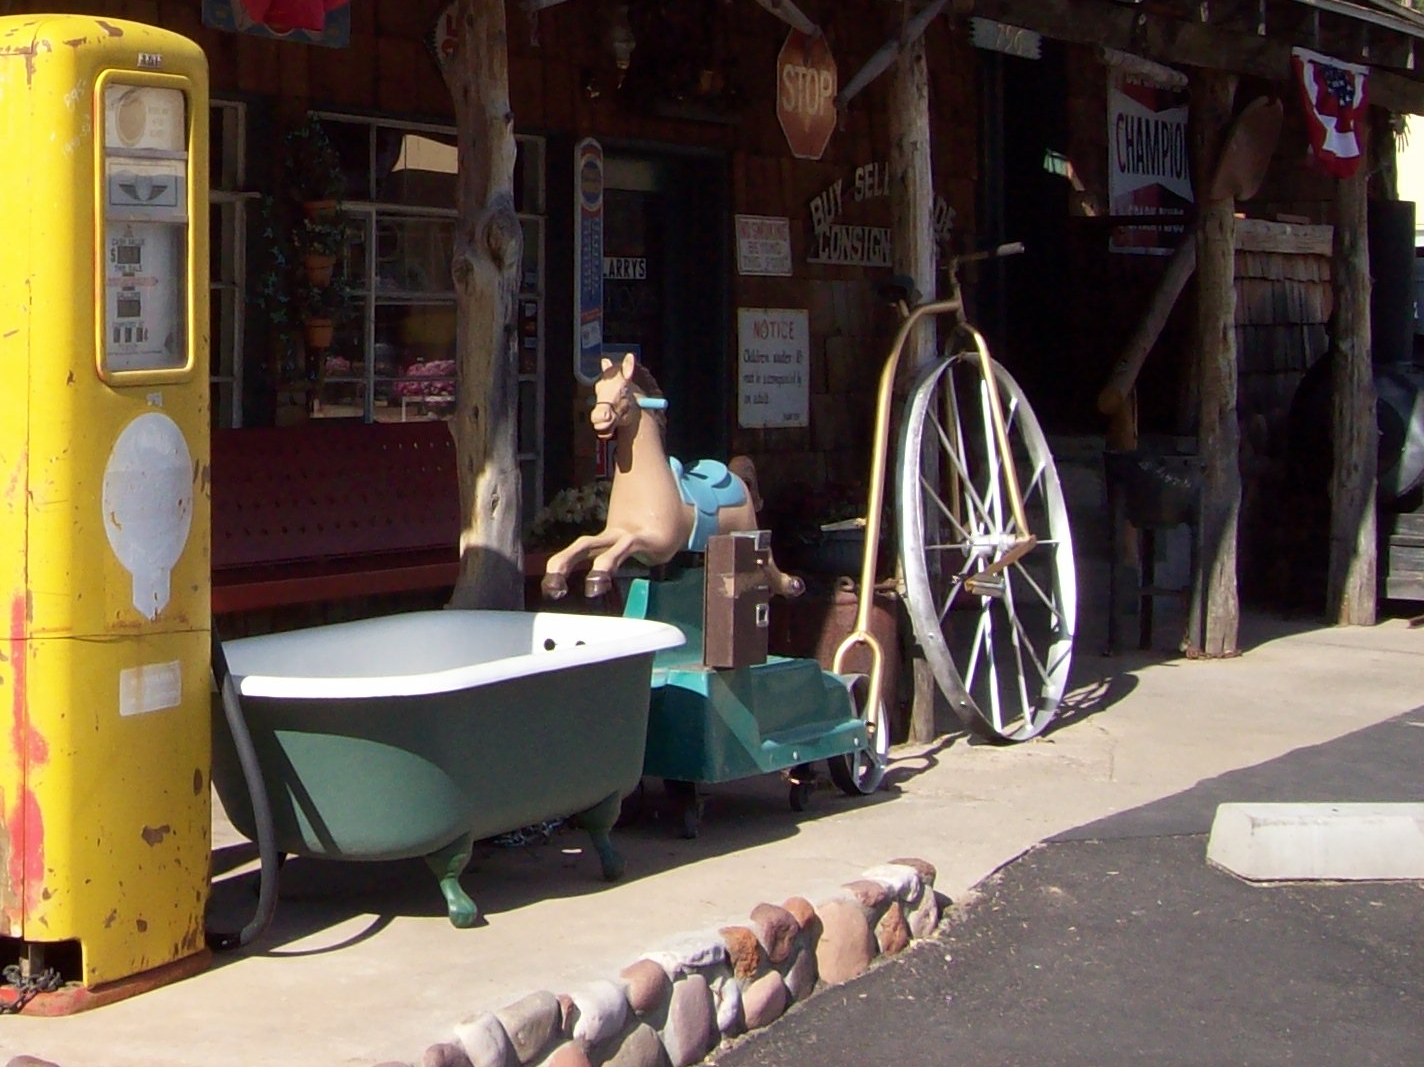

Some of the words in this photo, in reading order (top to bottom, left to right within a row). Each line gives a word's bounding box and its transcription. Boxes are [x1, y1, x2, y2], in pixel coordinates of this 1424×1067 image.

[782, 63, 833, 117] STOP
[809, 177, 843, 236] BUY
[753, 319, 794, 340] NOTICE
